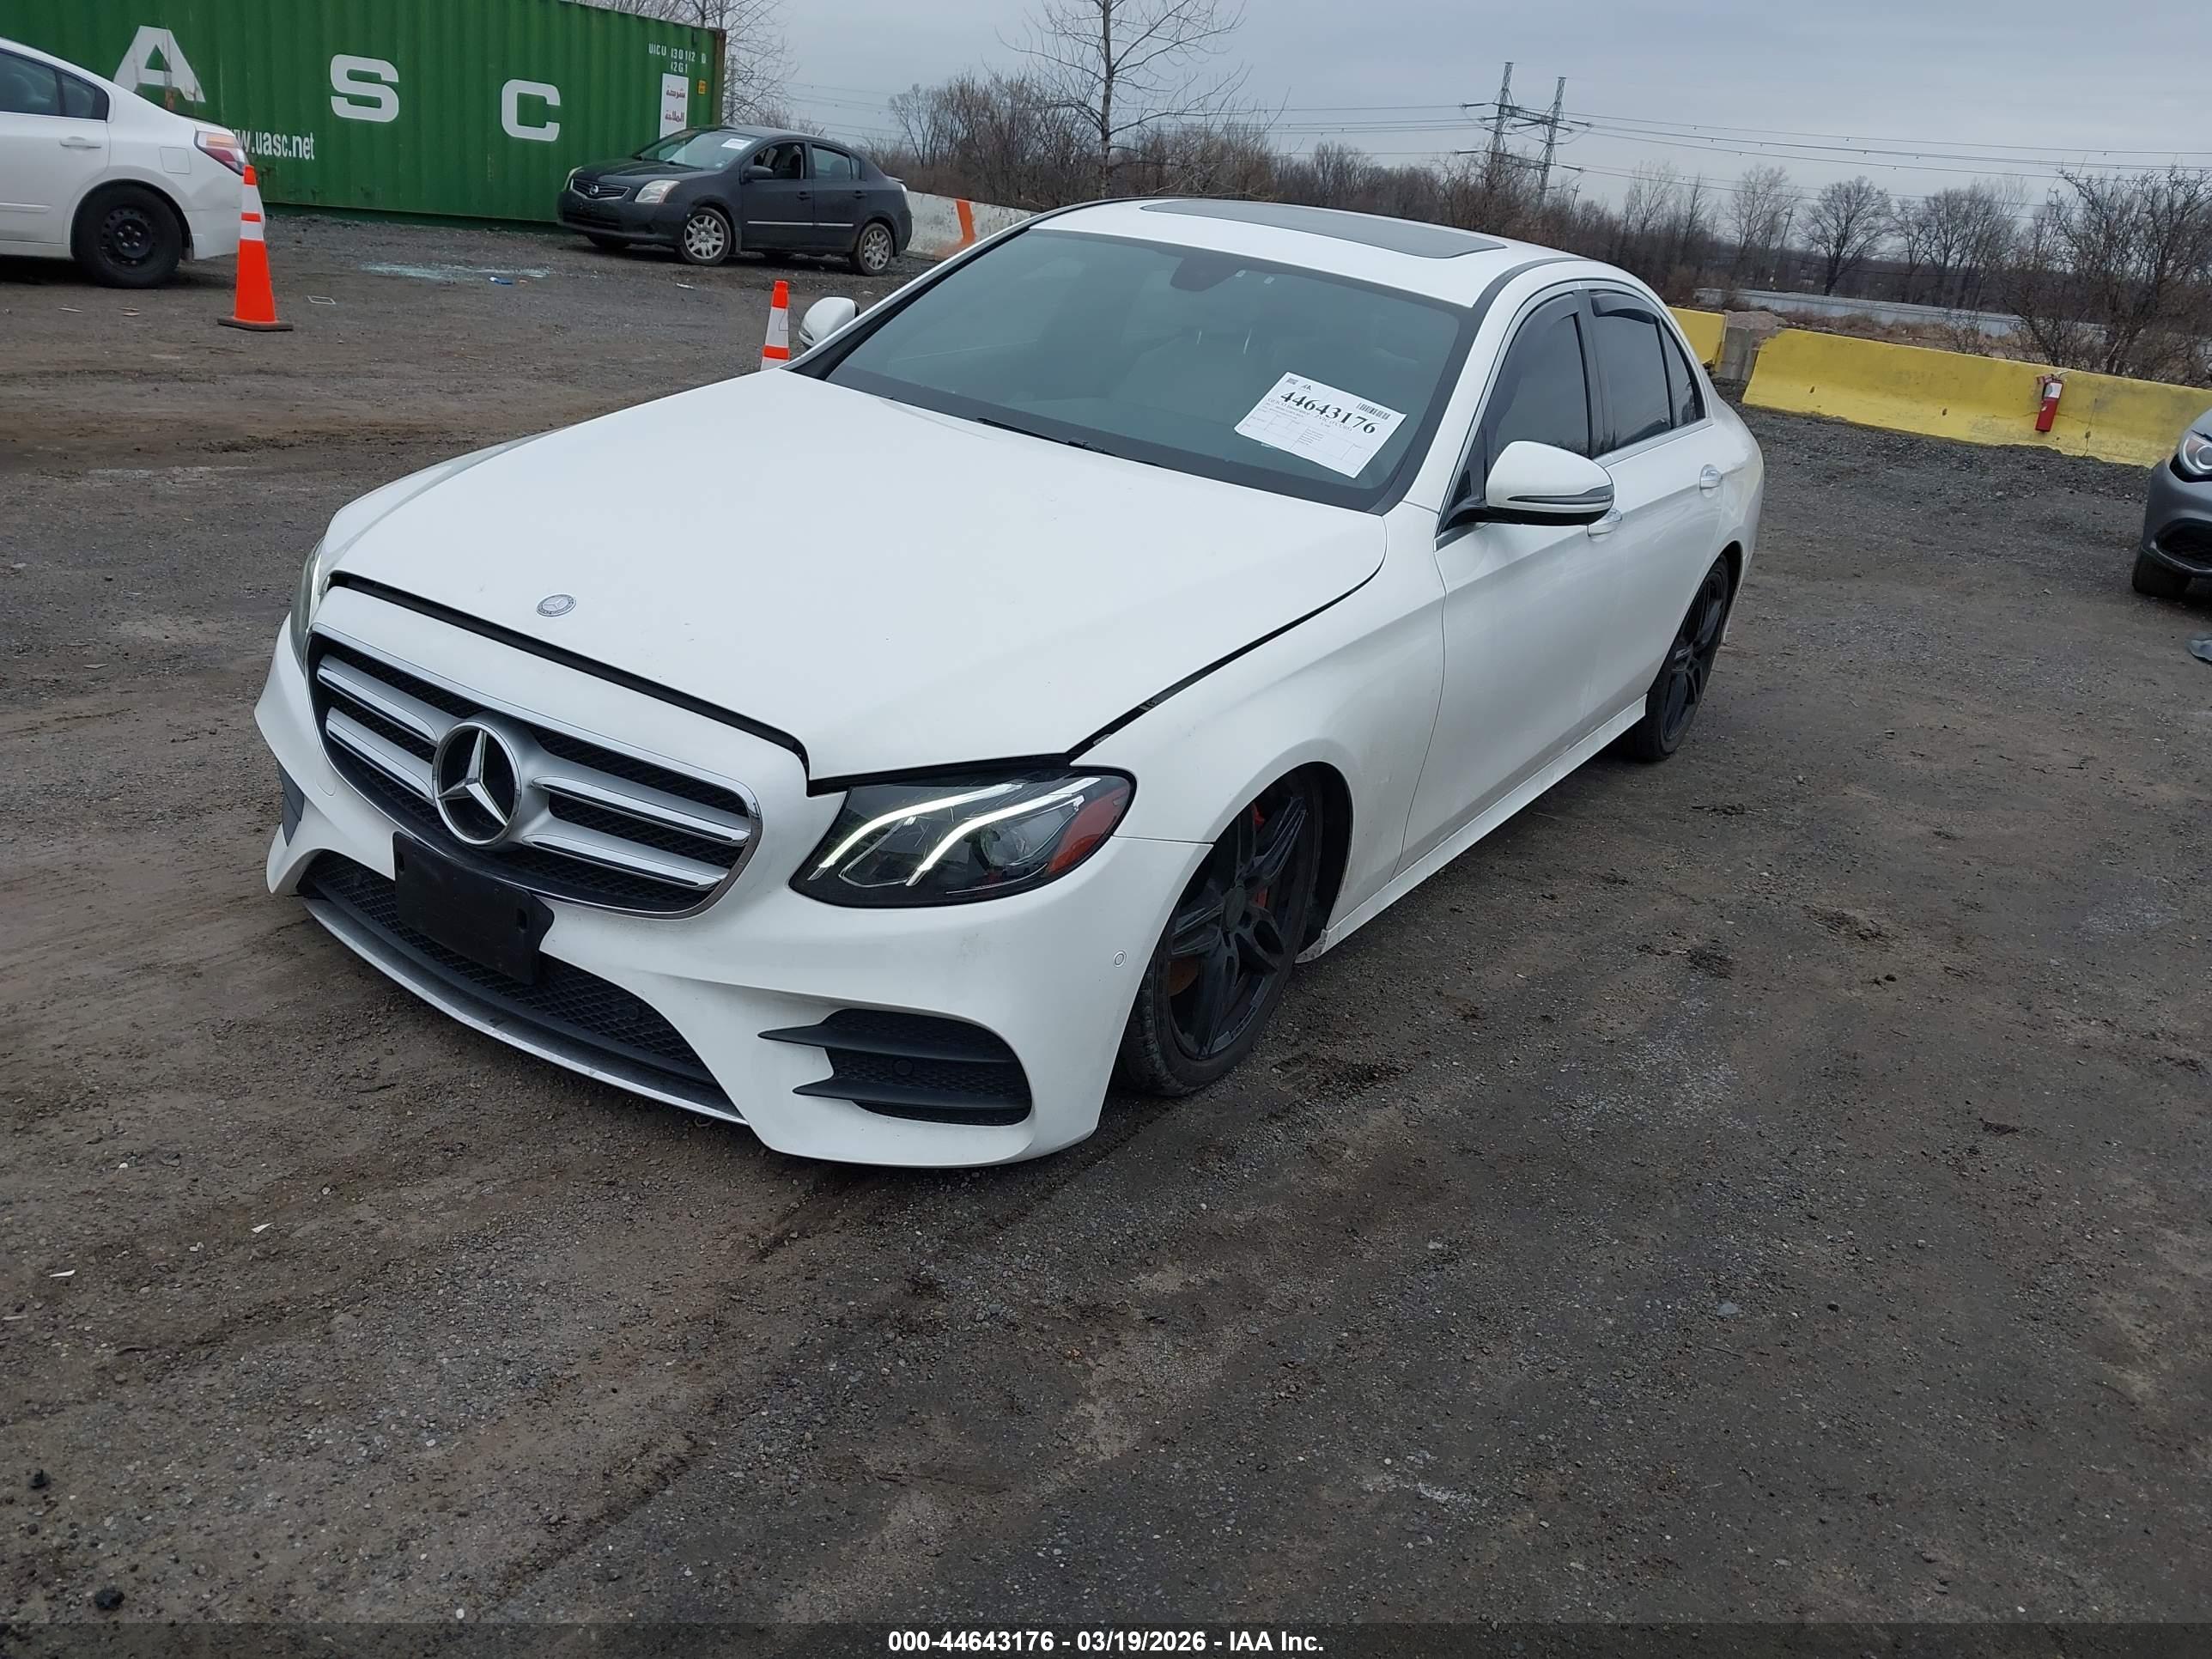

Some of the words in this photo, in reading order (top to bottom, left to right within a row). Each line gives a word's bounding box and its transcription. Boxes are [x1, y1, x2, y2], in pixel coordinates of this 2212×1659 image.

[112, 25, 206, 103] A
[330, 53, 400, 123] S
[501, 79, 561, 143] C
[1280, 391, 1379, 434] 44643176
